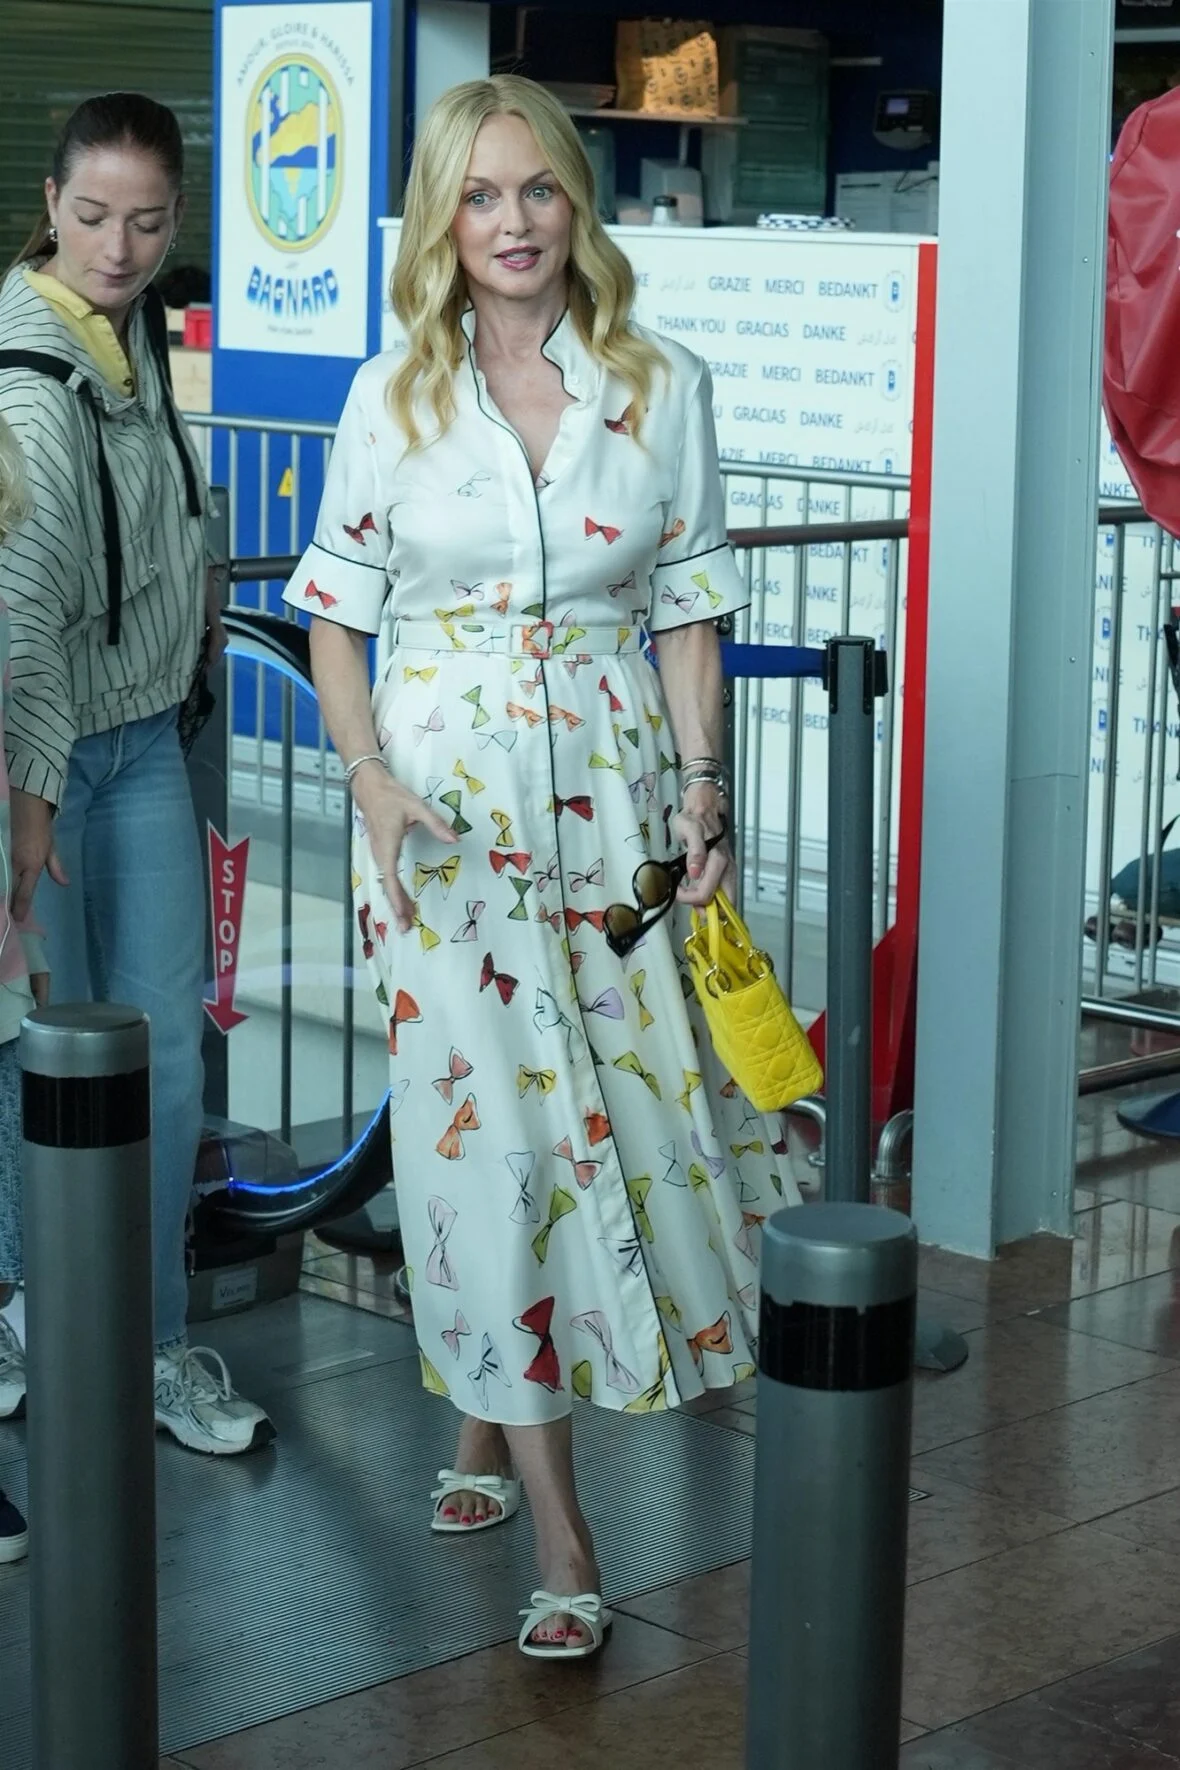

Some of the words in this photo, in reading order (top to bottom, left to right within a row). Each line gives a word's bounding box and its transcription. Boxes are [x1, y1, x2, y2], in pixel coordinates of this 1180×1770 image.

[269, 21, 309, 40] GLOIRE
[319, 32, 355, 88] HARISSA
[247, 264, 339, 318] BAGNARD
[708, 275, 751, 292] GRAZIE
[765, 279, 804, 295] MERCI
[818, 280, 878, 299] BEDANKT
[657, 315, 697, 332] THANK
[700, 318, 726, 334] YOU
[736, 319, 789, 338] GRACIAS
[803, 323, 846, 342] DANKE
[762, 365, 801, 382] MERCI
[815, 368, 875, 387] BEDANKT
[733, 405, 786, 424] GRACIAS
[800, 410, 843, 428] DANKE
[218, 859, 235, 974] STOP
